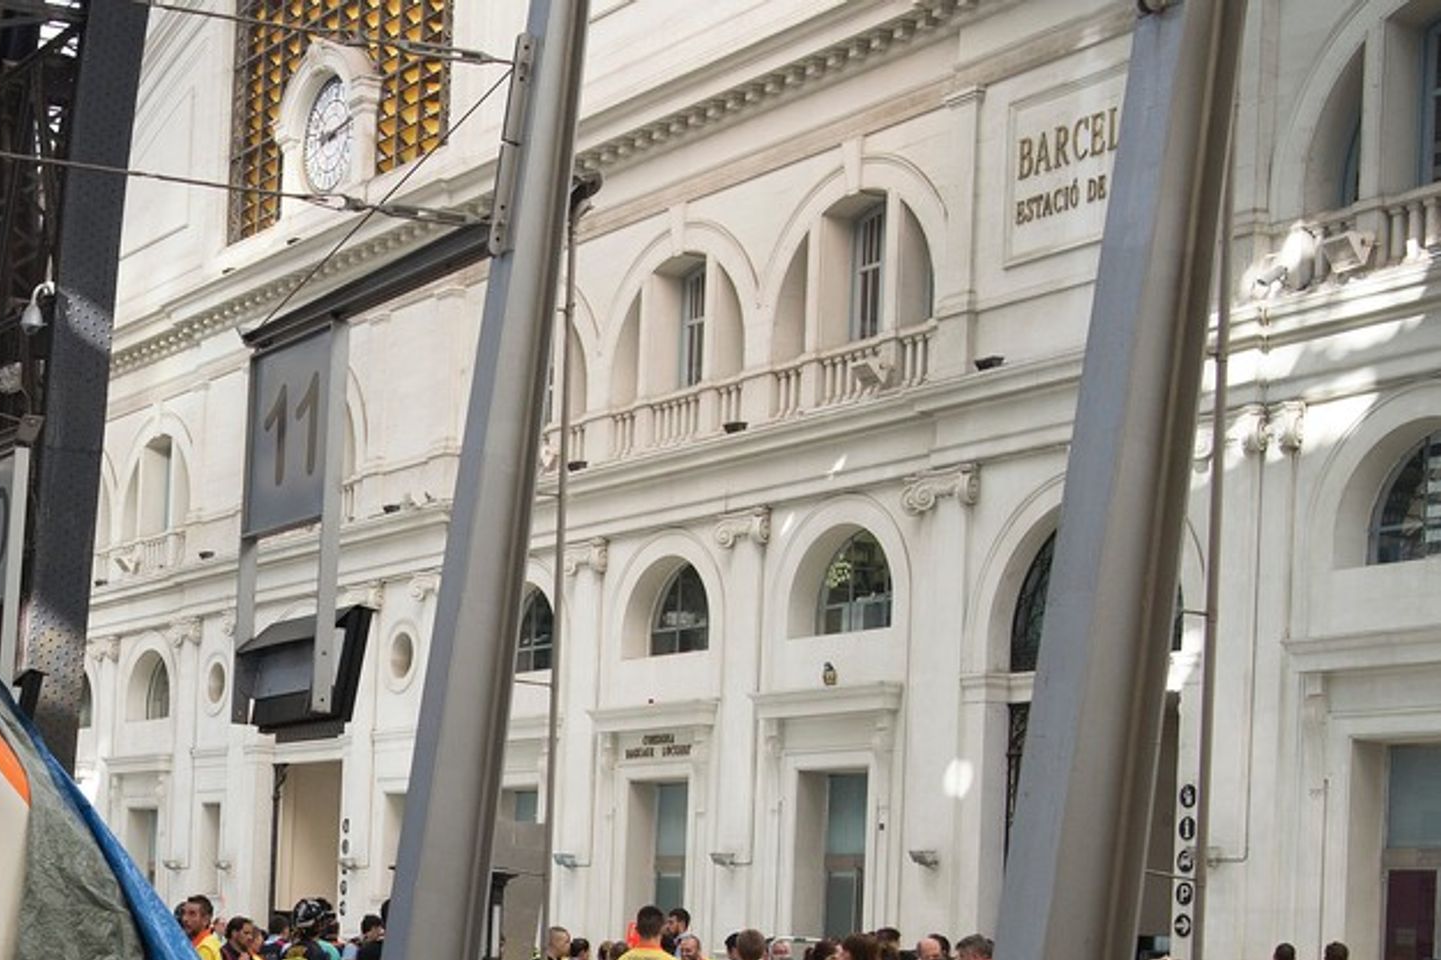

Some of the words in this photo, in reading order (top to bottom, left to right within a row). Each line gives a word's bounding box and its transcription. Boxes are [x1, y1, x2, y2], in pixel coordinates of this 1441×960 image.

[1017, 107, 1119, 180] BARCEL
[1015, 178, 1080, 225] ESTACIÓ
[1086, 174, 1107, 204] DE
[263, 370, 320, 487] 11
